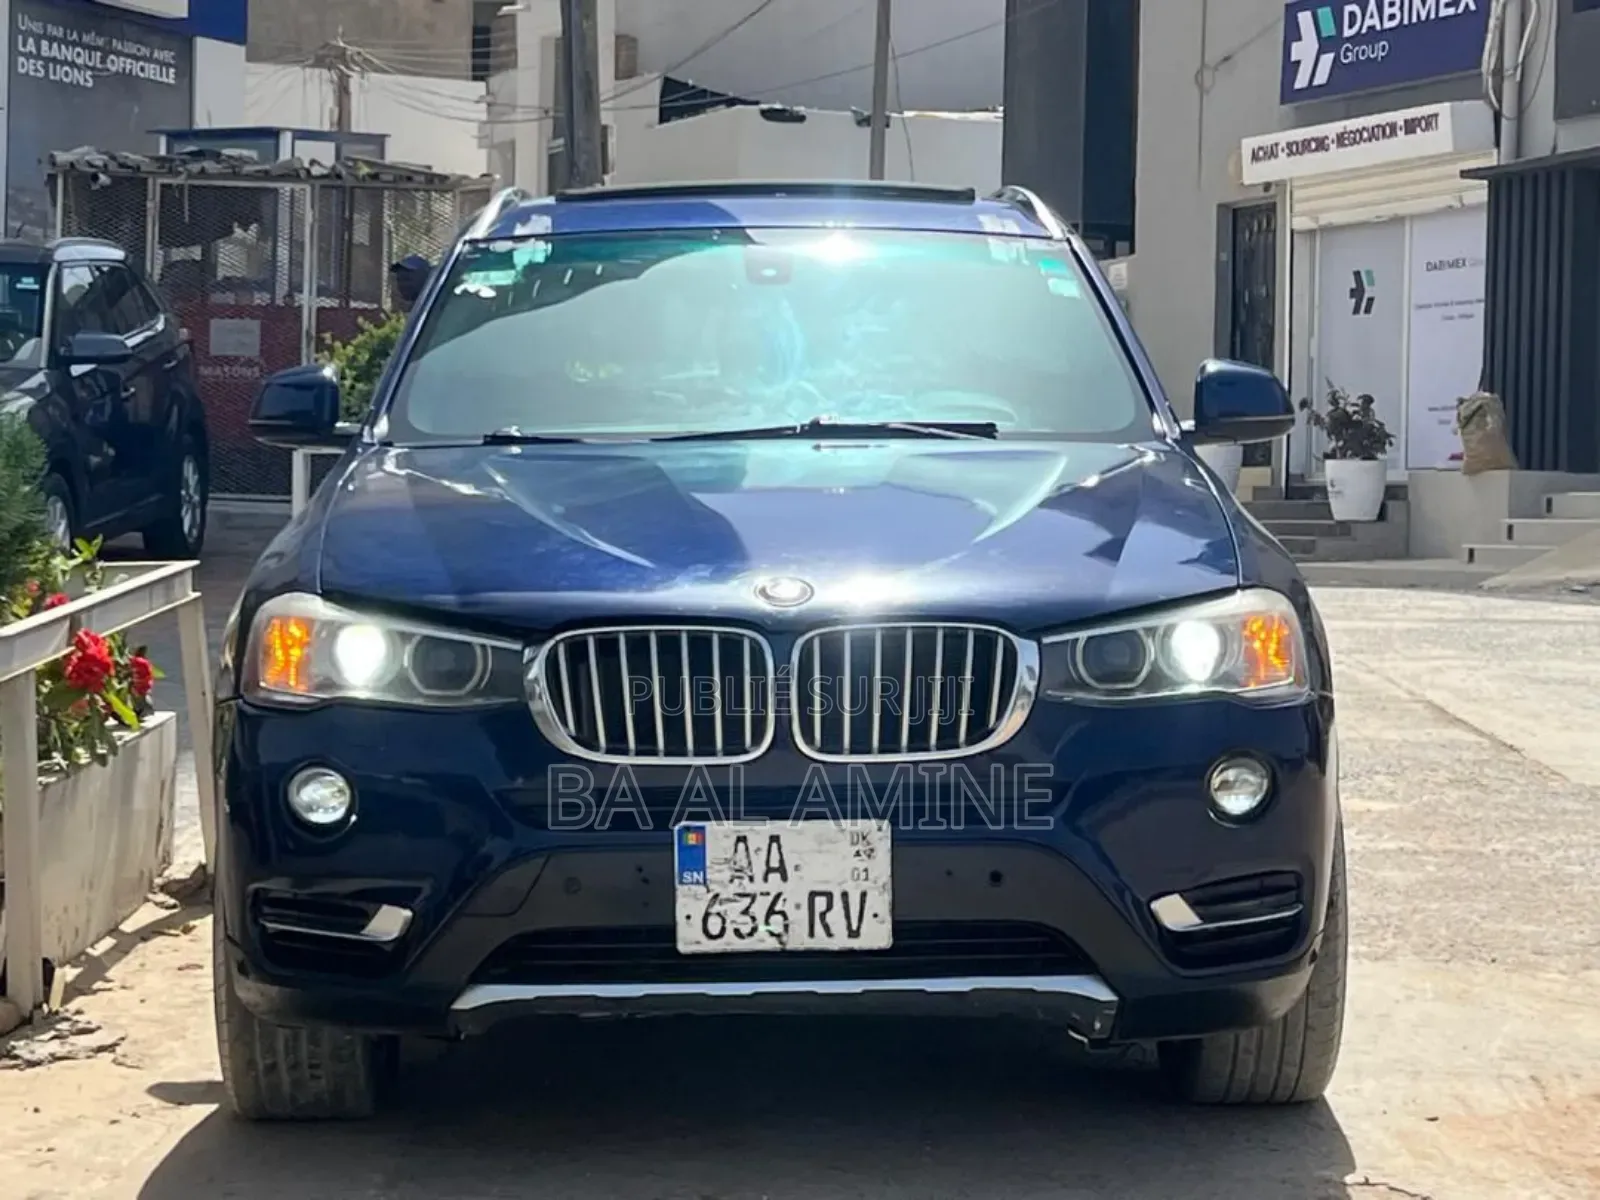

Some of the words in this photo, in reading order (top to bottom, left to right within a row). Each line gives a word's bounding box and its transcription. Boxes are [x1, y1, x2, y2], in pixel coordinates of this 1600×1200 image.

[18, 35, 38, 54] LA
[41, 39, 103, 68] BANQUE
[106, 54, 176, 84] OFFICIELLE
[47, 23, 65, 39] PAR
[66, 28, 79, 42] LA
[152, 48, 176, 64] AVEC
[1340, 40, 1389, 64] Group
[18, 56, 45, 78] DES
[49, 63, 94, 88] LIONS
[1250, 142, 1281, 164] ACHAT
[1286, 135, 1330, 158] SOURCING
[1336, 125, 1398, 149] NÉGOCIATION
[1404, 112, 1440, 136] IMPORT
[683, 871, 704, 884] SN
[852, 868, 870, 882] 01
[729, 835, 788, 883] AA
[851, 831, 872, 847] DK
[701, 891, 789, 940] 636
[807, 890, 867, 939] RV
